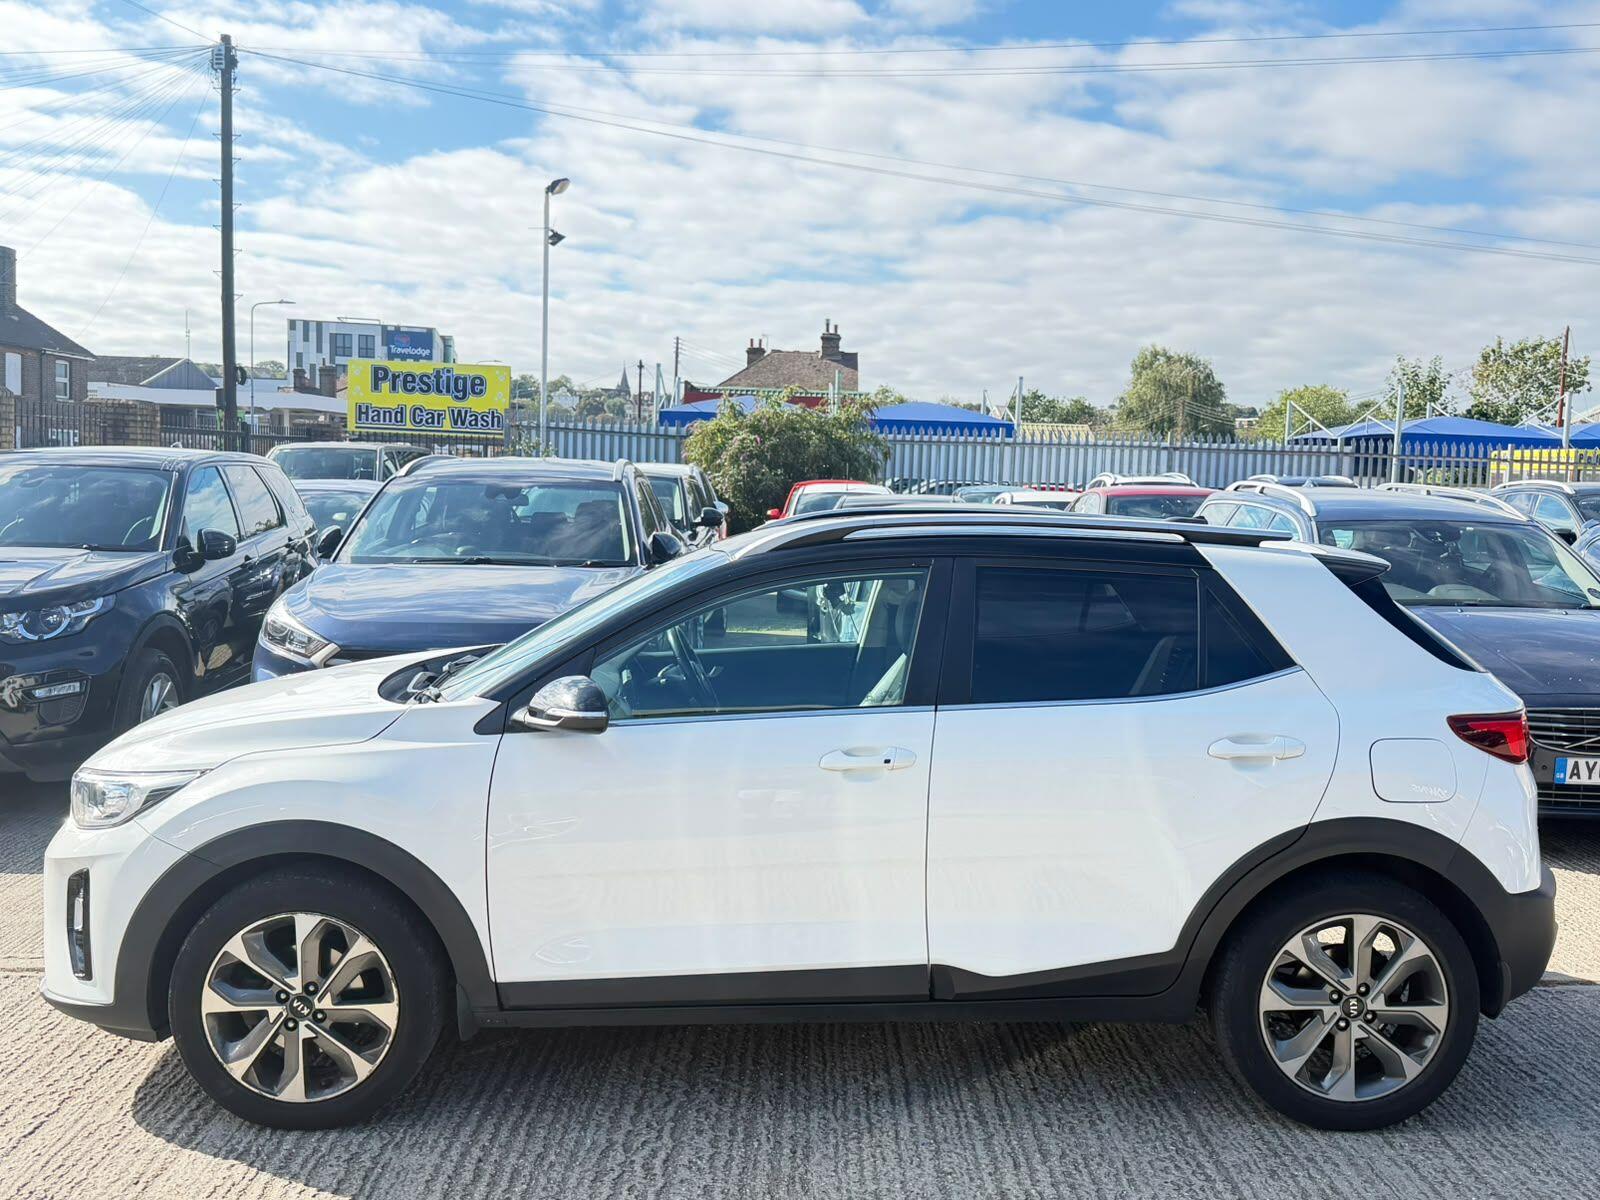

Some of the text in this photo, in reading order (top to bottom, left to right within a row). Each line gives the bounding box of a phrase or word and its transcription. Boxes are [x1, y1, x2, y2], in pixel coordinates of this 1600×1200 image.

[390, 344, 430, 357] Travelodge
[371, 364, 487, 402] Prestige
[355, 403, 504, 430] Hand Car Wash
[1569, 760, 1600, 780] AY
[293, 998, 310, 1016] KIA
[1350, 998, 1358, 1017] KIA
